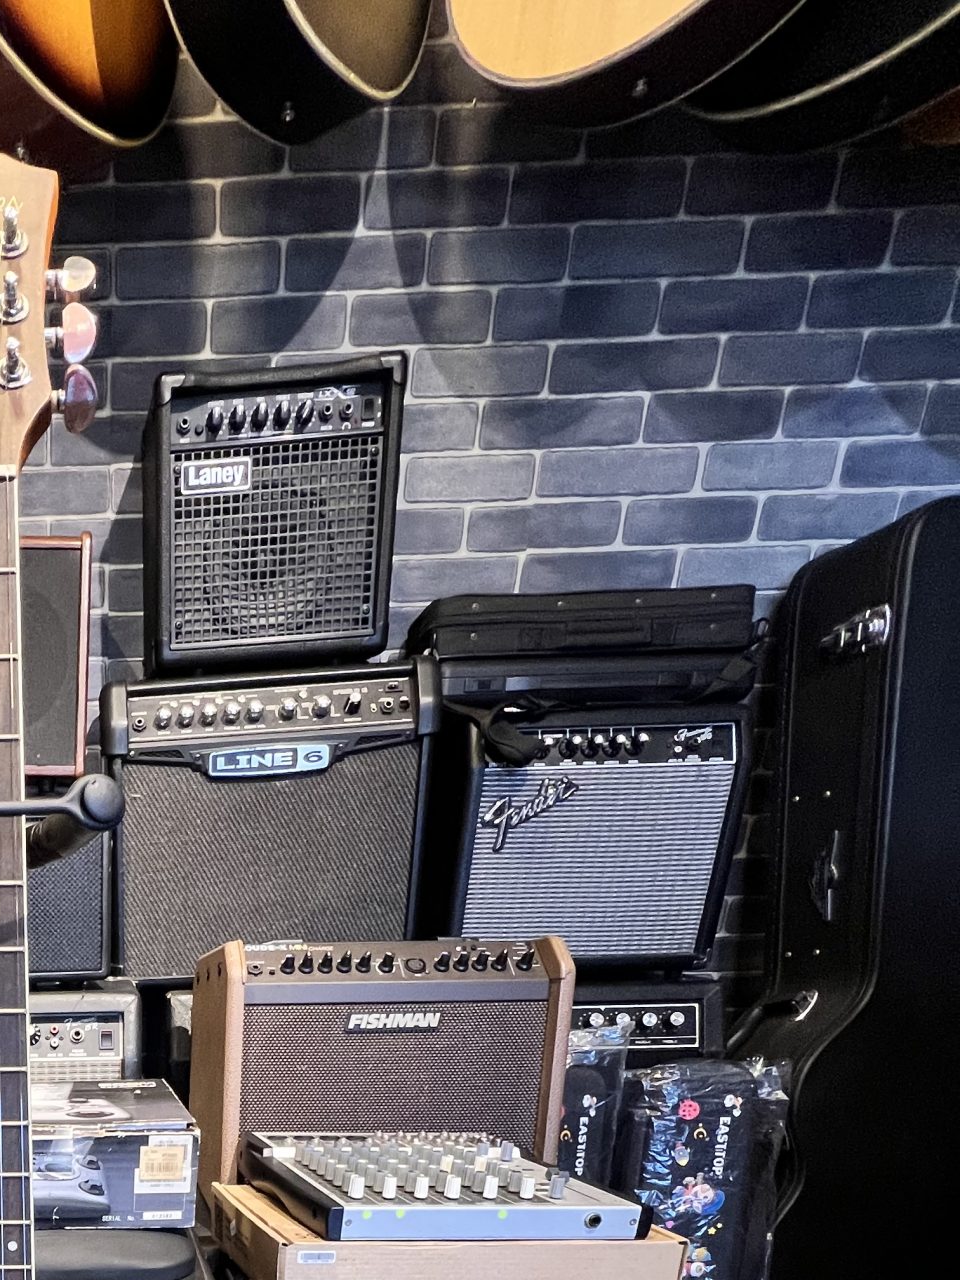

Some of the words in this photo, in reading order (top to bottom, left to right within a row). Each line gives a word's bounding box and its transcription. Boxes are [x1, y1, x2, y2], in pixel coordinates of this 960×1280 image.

[188, 464, 245, 487] Laney
[216, 751, 294, 771] LINE
[302, 749, 324, 764] 6
[477, 776, 580, 852] Fender
[347, 1012, 441, 1030] FISHMAN
